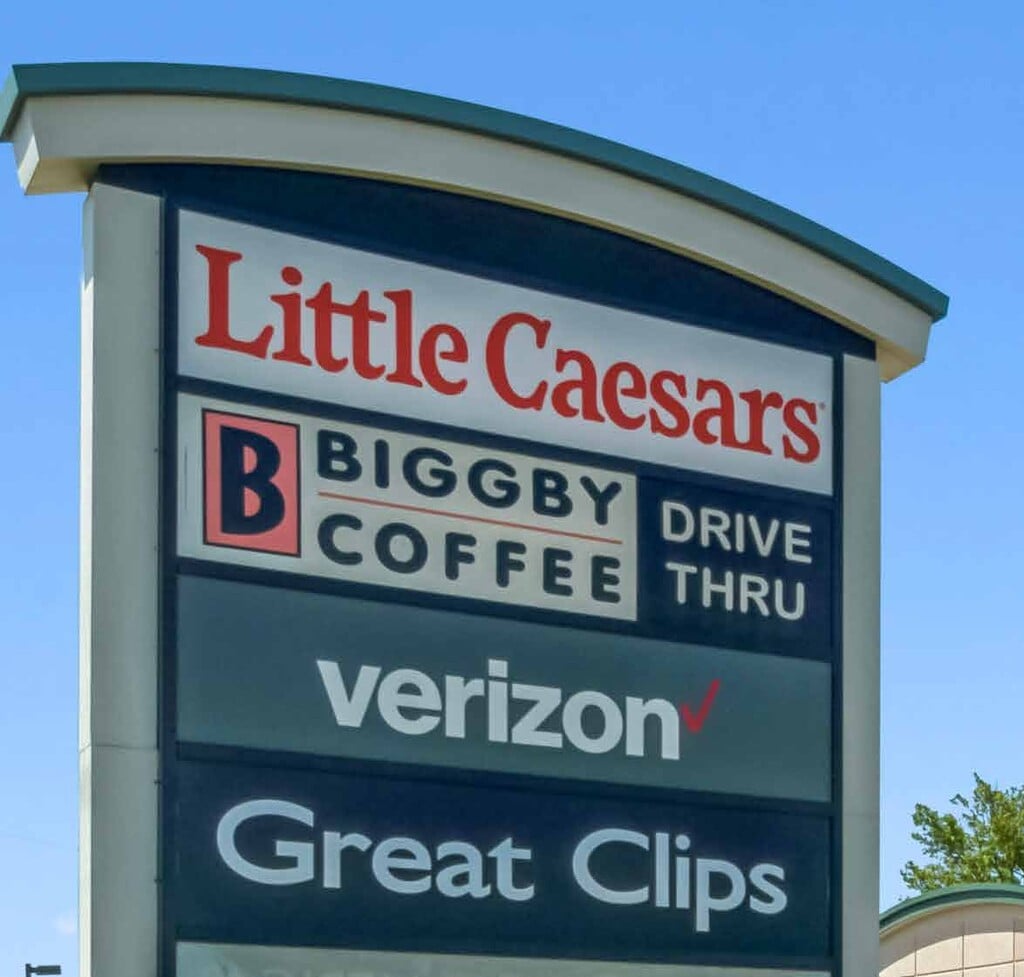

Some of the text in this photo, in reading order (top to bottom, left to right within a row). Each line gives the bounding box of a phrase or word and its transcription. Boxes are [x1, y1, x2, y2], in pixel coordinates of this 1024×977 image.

[195, 244, 821, 463] Little Caesars
[219, 423, 286, 536] B
[316, 429, 623, 526] BIGGBY
[316, 513, 623, 604] COFFEE
[661, 500, 813, 565] DRIVE
[664, 561, 806, 622] THRU
[316, 659, 681, 760] verizon
[216, 798, 789, 933] Great Clips
